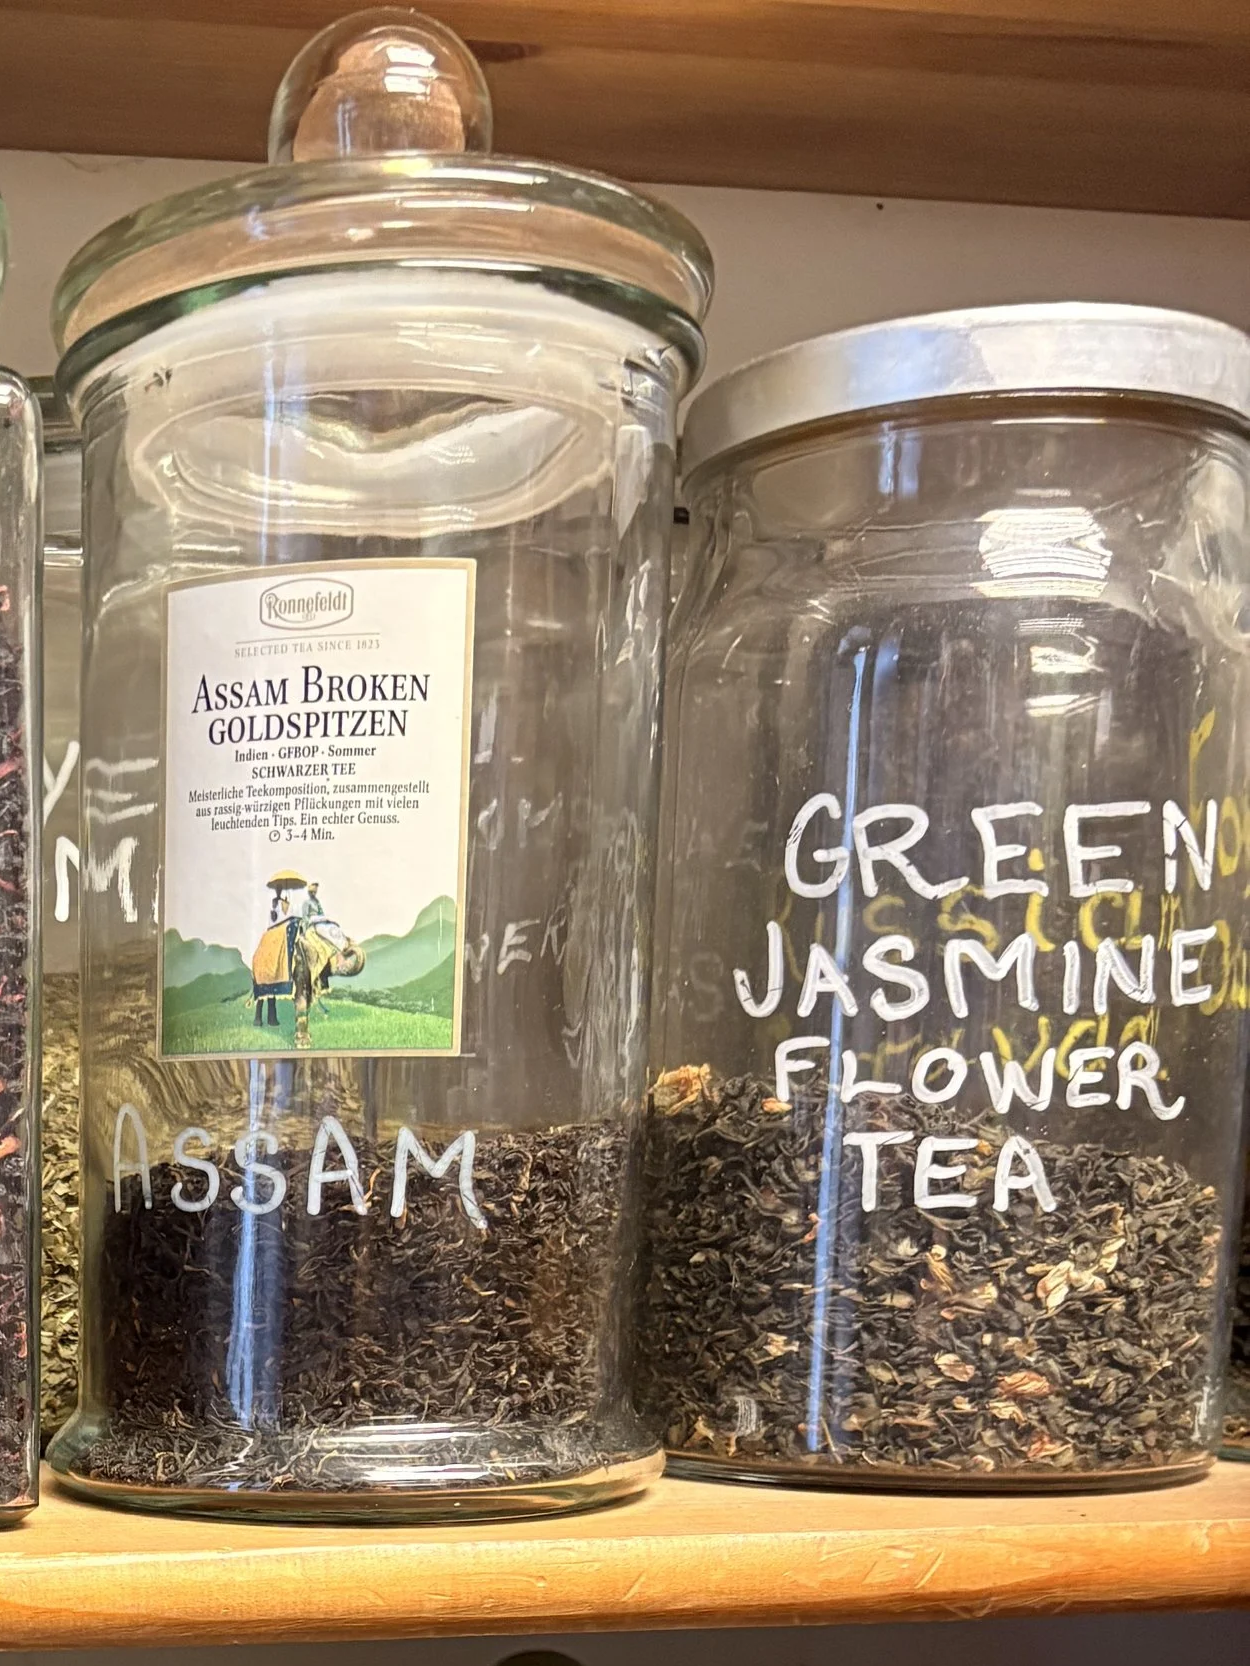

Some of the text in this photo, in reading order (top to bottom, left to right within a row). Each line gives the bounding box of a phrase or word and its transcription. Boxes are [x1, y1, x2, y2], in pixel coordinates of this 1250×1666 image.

[264, 590, 348, 621] Ronnefeldt
[234, 642, 289, 659] SELECTED
[292, 641, 313, 653] TEA
[317, 639, 352, 652] SINCE
[191, 665, 431, 714] ASSAM BROKEN
[208, 709, 409, 746] GOLDSPITZEN
[234, 744, 377, 763] Indien GFBOP Sommer
[251, 762, 357, 780] SCHWARZER TEE
[189, 780, 430, 803] Meisterliche Teekomposition, zusammengestellt
[195, 795, 420, 818] aus rassig-würzigen Pflückungen mit vielen
[210, 809, 400, 832] leuchtenden Tips. Ein echter Genuss.
[310, 827, 335, 841] Min.
[784, 792, 1218, 900] GREEN
[733, 921, 1218, 1022] JASMINE
[774, 1036, 1186, 1121] FLOWER
[112, 1102, 488, 1231] ASSAM
[843, 1131, 1057, 1212] TEA
